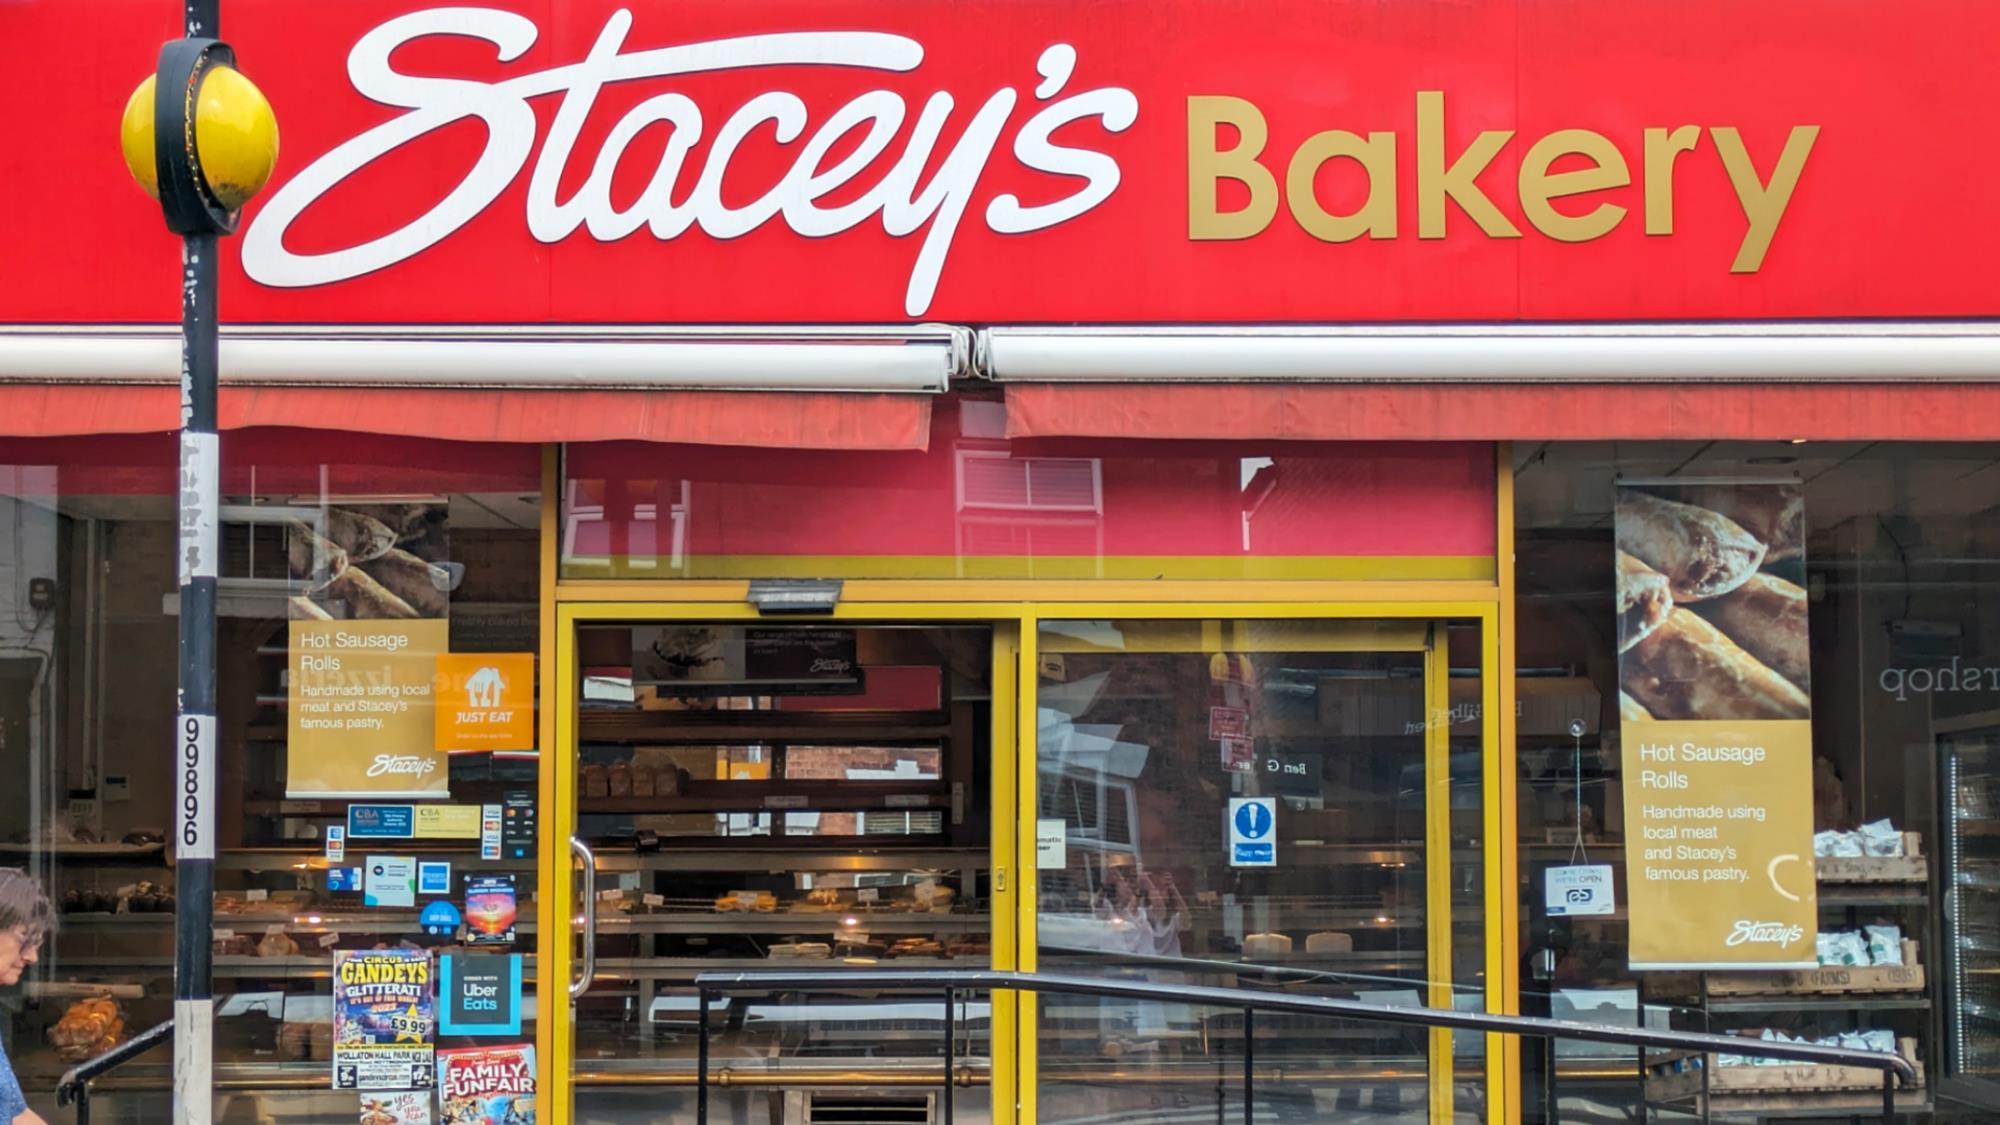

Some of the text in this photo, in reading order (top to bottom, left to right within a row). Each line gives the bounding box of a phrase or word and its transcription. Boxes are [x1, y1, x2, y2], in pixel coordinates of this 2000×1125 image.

[241, 6, 1138, 317] Stacey's
[1188, 91, 1821, 273] Bakery
[300, 632, 408, 651] Hot Sausage
[300, 656, 341, 671] Rolls
[300, 684, 431, 699] Handmade using local
[300, 701, 408, 715] meat and Stacey's
[300, 717, 384, 731] famous pastry.
[455, 711, 514, 725] JUST EAT
[1640, 743, 1766, 766] Hot Sausage
[366, 753, 436, 780] Stacey's
[183, 717, 199, 846] 99896
[1641, 770, 1689, 789] Rolls
[1642, 804, 1766, 822] Handmade using
[1643, 825, 1718, 840] local meat
[1644, 846, 1737, 863] and Stacey's
[1579, 875, 1602, 883] OPEN
[1645, 866, 1750, 883] famous pastry.
[1725, 920, 1804, 949] Stacey's
[341, 962, 428, 985] GANDEYS
[346, 983, 421, 998] GLITTERATI
[463, 983, 498, 997] Uber
[463, 997, 498, 1010] Eats
[391, 1017, 426, 1034] £9.99
[337, 1051, 373, 1060] WOLLATON
[375, 1051, 392, 1060] HALL
[393, 1051, 410, 1060] PARK
[449, 1063, 525, 1083] FAMILY
[443, 1077, 534, 1100] FUNFAIR
